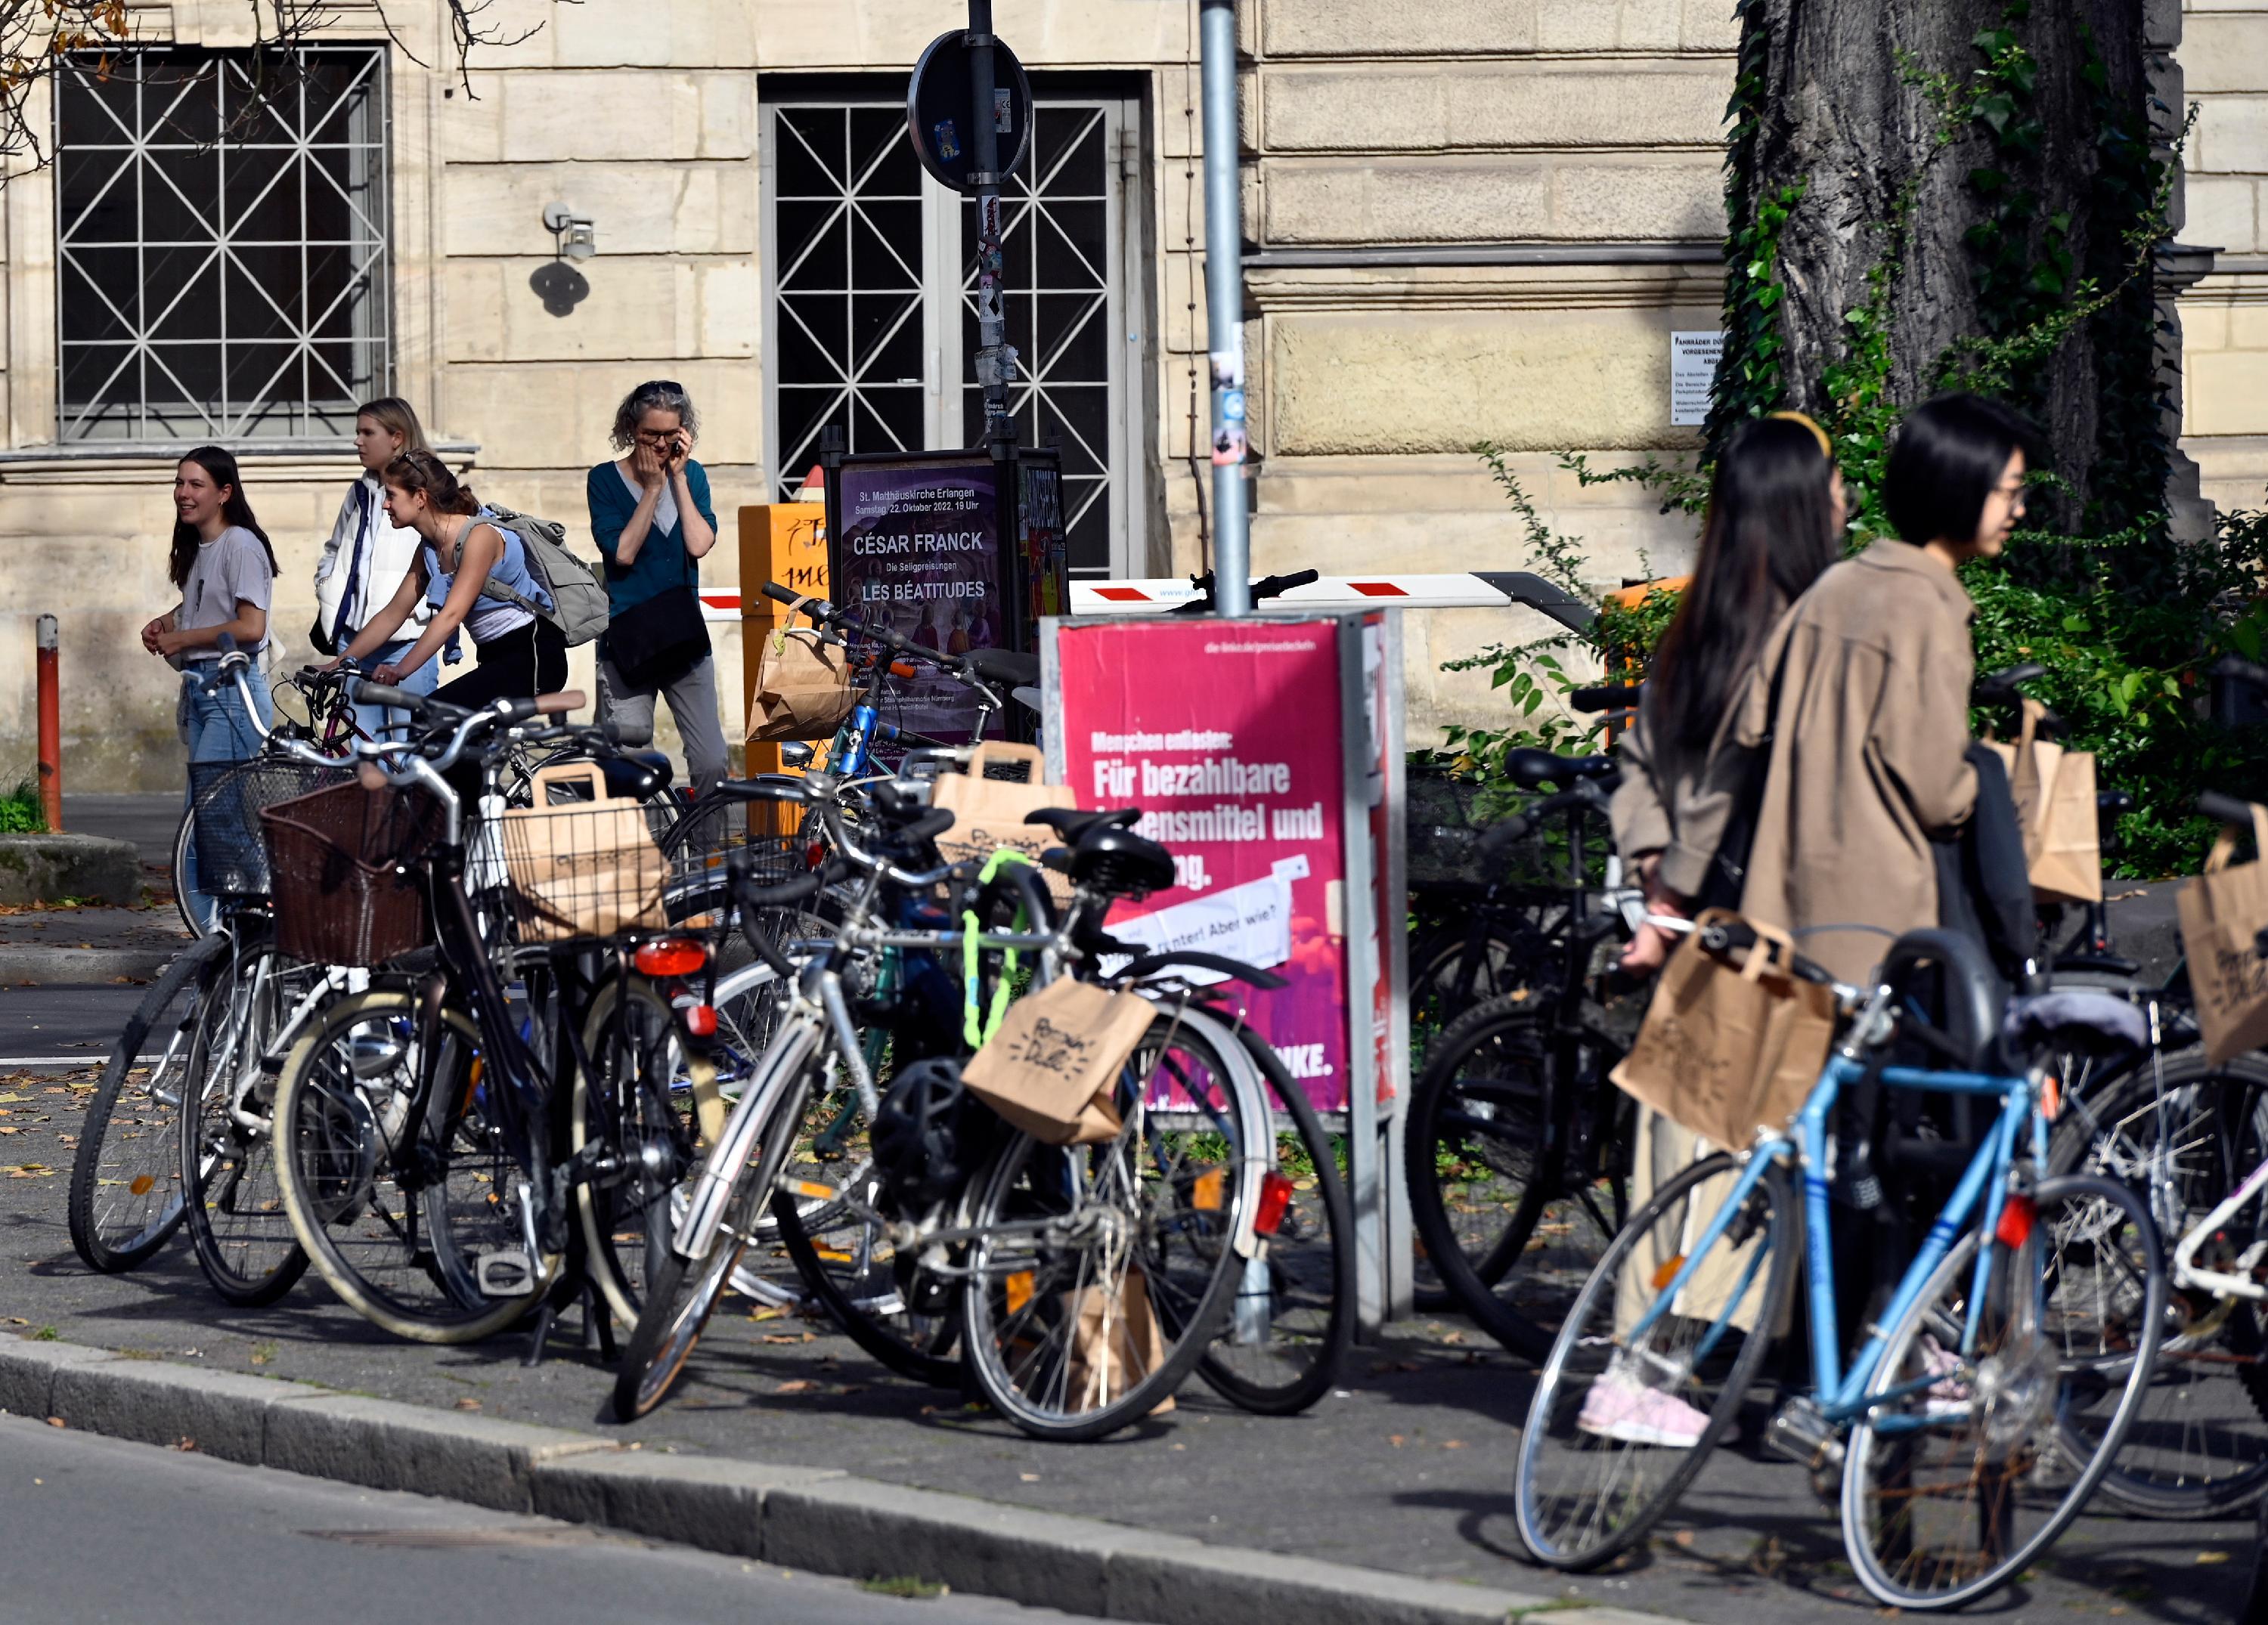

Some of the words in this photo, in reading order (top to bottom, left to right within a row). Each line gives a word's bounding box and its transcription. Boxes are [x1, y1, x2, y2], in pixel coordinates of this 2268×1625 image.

[860, 491, 870, 502] St.
[872, 490, 935, 501] Matthäuskirche
[937, 488, 974, 500] Erlangen
[855, 504, 888, 515] Samstag,
[890, 504, 901, 513] 22.
[903, 503, 931, 512] Oktober
[934, 502, 953, 511] 2022,
[965, 501, 979, 509] Uhr
[854, 532, 910, 556] CÉSAR
[914, 531, 984, 552] FRANCK
[886, 562, 898, 572] Die
[899, 561, 957, 573] Seligpreisungen
[863, 584, 890, 602] LES
[894, 580, 985, 601] BÉATITUDES
[1094, 759, 1136, 798] Für
[1142, 757, 1290, 797] bezahlbare
[1128, 802, 1267, 842] ensmittel
[1272, 801, 1324, 841] und
[1210, 918, 1241, 938] Aber
[1244, 904, 1277, 926] wie?
